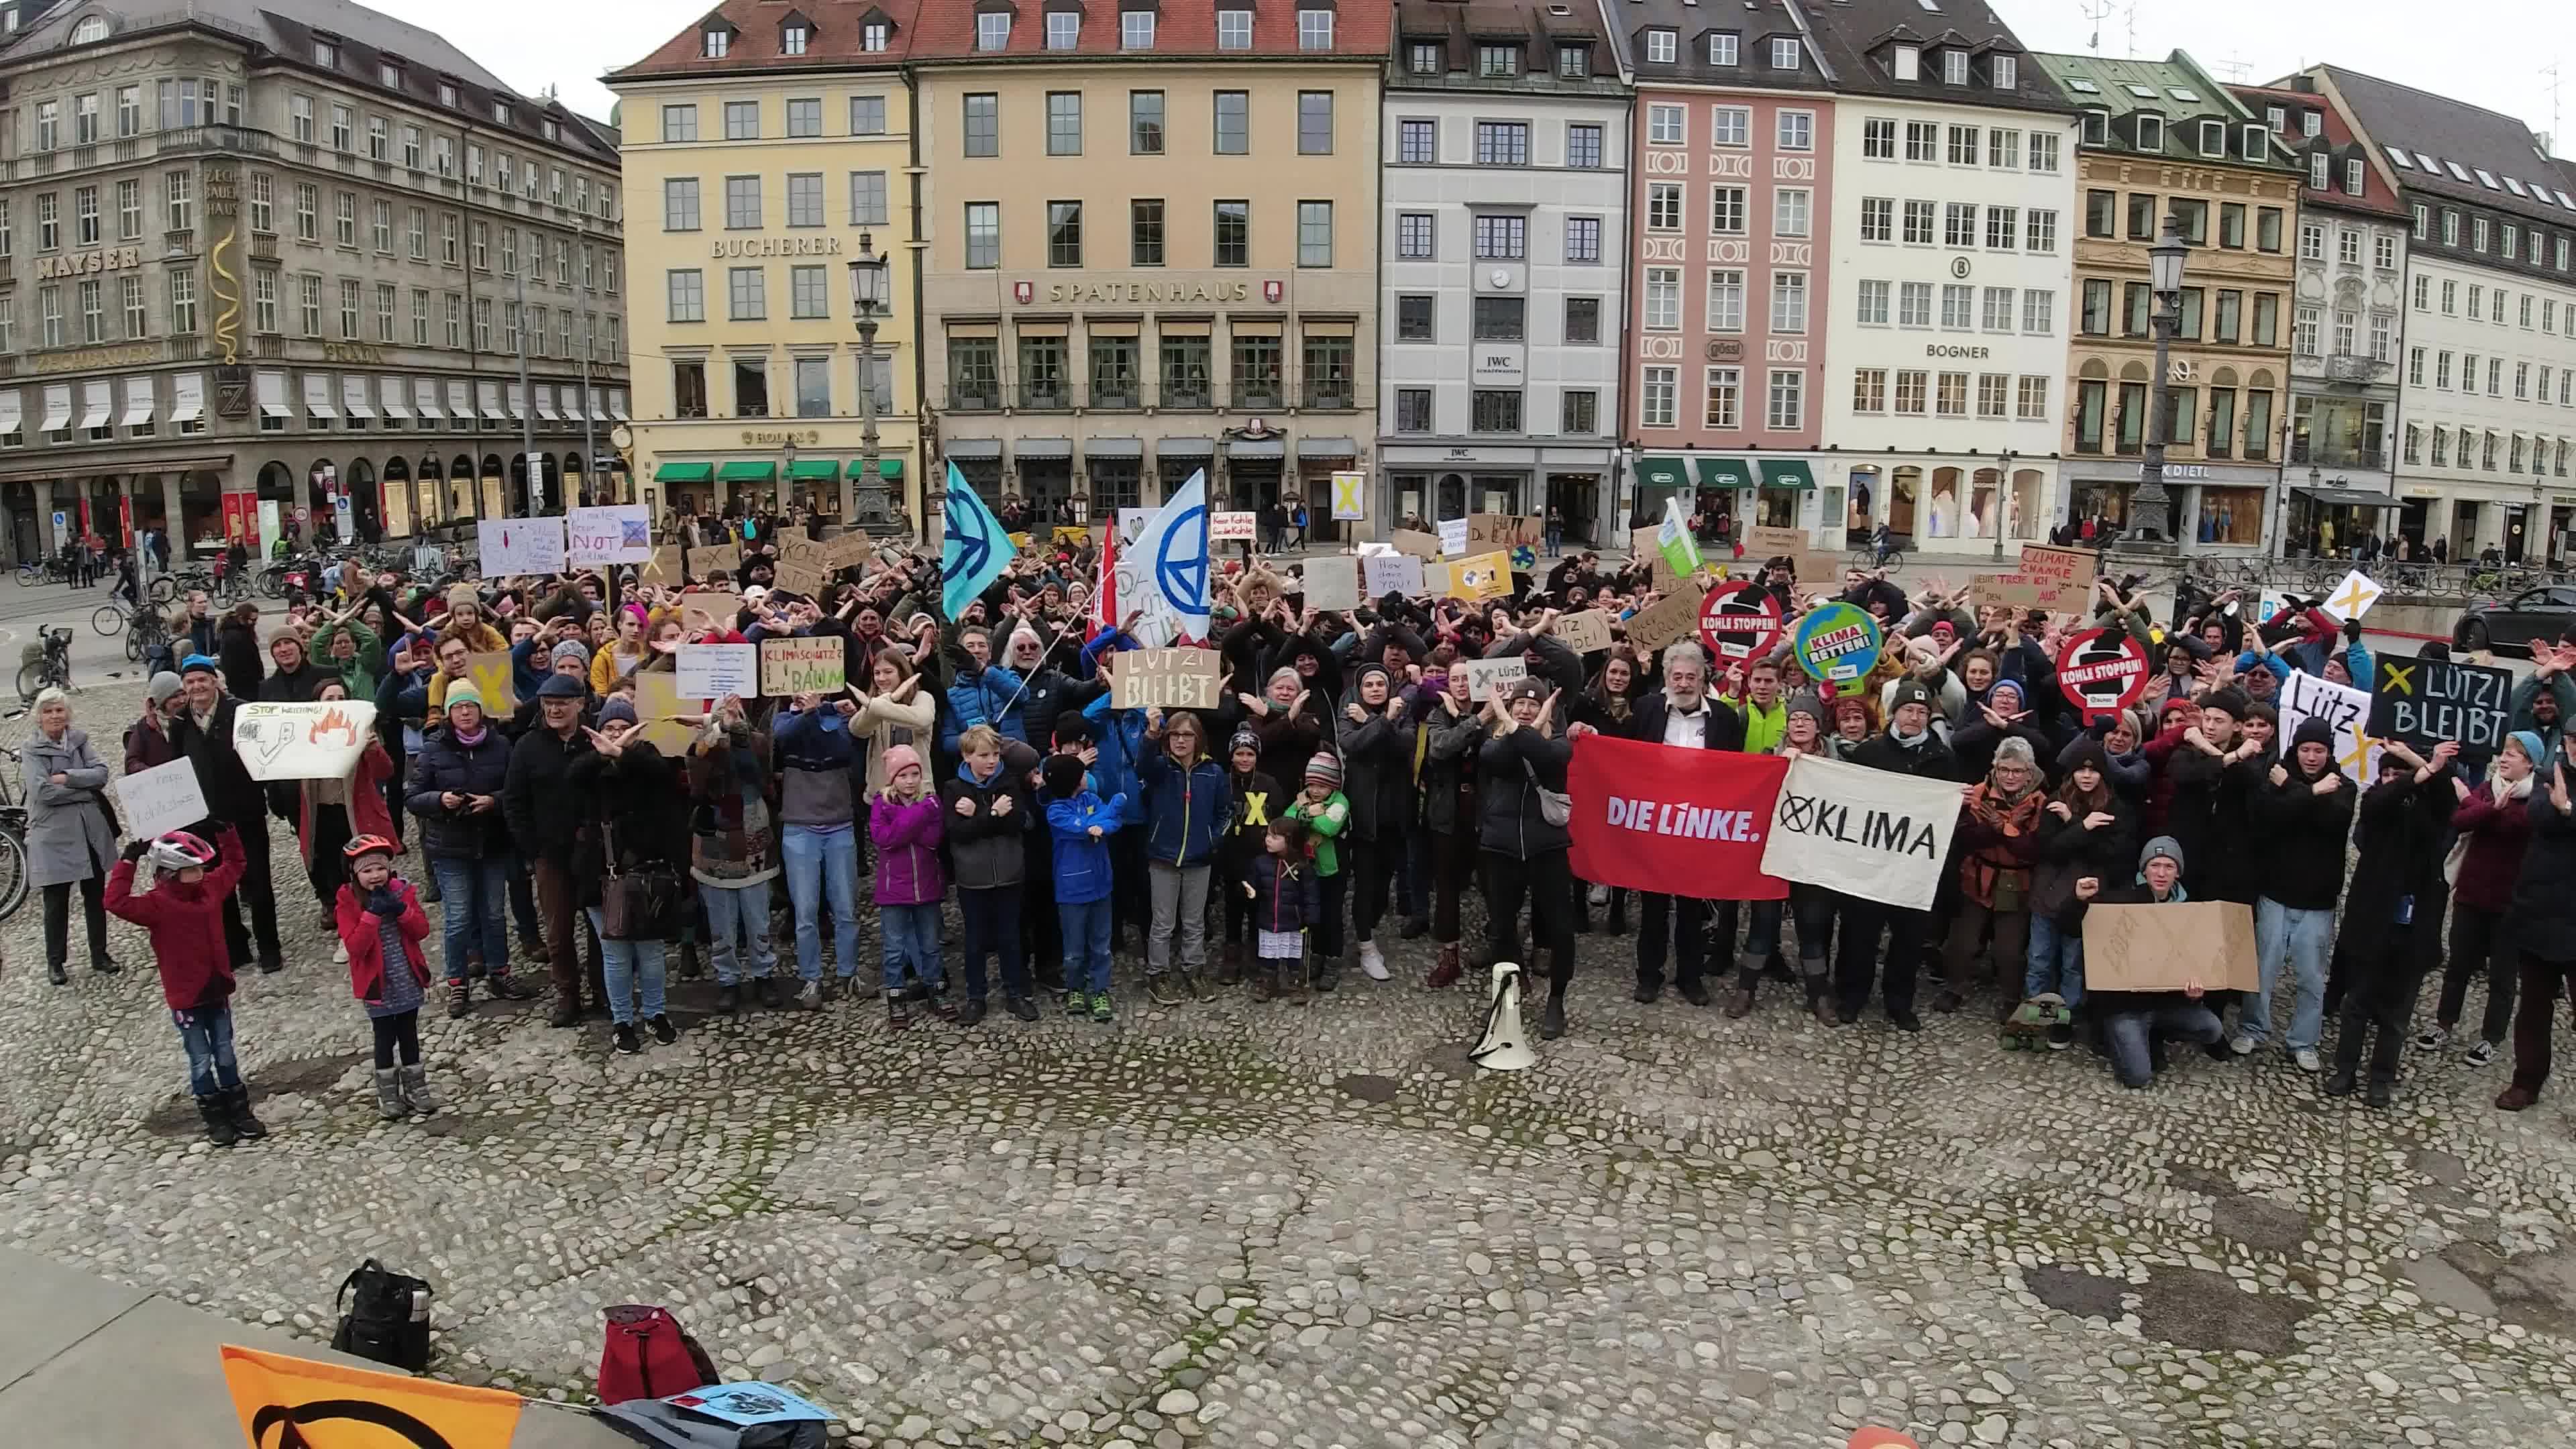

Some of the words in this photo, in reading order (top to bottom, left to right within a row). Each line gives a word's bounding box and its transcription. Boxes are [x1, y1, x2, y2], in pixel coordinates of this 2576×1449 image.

[712, 237, 843, 258] BUCHERER
[38, 248, 139, 280] MAYSER
[1050, 284, 1248, 302] SPATENHAUS
[1487, 356, 1511, 367] IWC
[1927, 344, 1990, 360] BOGNER
[1451, 449, 1468, 457] IWC
[2174, 466, 2210, 478] DIETL
[2021, 549, 2078, 568] CLIMATE
[2019, 564, 2072, 580] CHANGE
[1702, 616, 1731, 629] KOHLE
[1733, 617, 1776, 631] STOPPEN!
[1811, 625, 1860, 649] KLIMA
[1809, 635, 1872, 664] RETTEN!
[792, 669, 844, 692] BAUM
[2061, 667, 2094, 685] KOHLE
[2094, 659, 2143, 680] STOPPEN!
[2426, 665, 2506, 710] LÜTZI
[247, 706, 279, 714] STOP
[2394, 700, 2508, 747] BLEIBT
[1607, 796, 1655, 830] DIE
[1813, 799, 1935, 859] KLIMA
